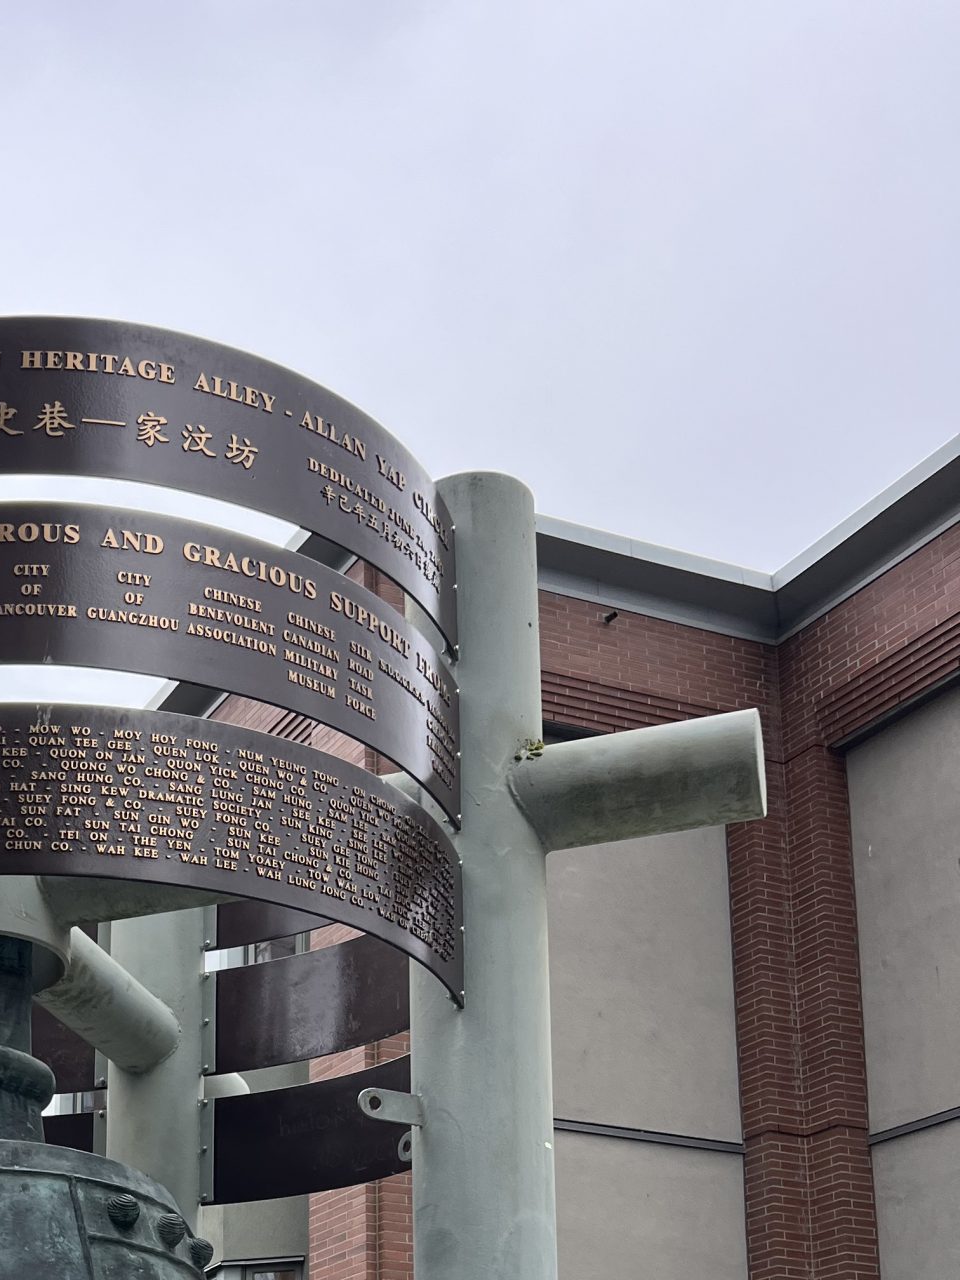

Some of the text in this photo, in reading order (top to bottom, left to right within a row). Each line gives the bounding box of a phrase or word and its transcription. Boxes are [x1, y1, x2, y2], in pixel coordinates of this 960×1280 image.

[20, 350, 176, 385] HERITAGE
[193, 372, 276, 413] ALLEY
[299, 410, 367, 461] ALLAN
[376, 453, 407, 492] YAP
[307, 457, 386, 513] DEDICATED
[13, 564, 50, 577] CITY
[117, 571, 152, 587] CITY
[20, 584, 42, 596] OF
[101, 528, 165, 555] AND
[183, 541, 317, 600] GRACIOUS
[330, 591, 411, 659] SUPPORT
[124, 592, 144, 605] OF
[204, 587, 262, 613] CHINESE
[87, 607, 179, 630] GUANGZHOU
[188, 603, 276, 636] BENEVOLENT
[288, 612, 336, 641] CHINESE
[186, 623, 277, 656] ASSOCIATION
[283, 629, 340, 663] CANADIAN
[350, 641, 373, 663] SILK
[284, 650, 338, 681] MILITARY
[348, 659, 374, 681] ROAD
[288, 670, 336, 699] MUSEUM
[349, 678, 374, 700] TASK
[346, 695, 377, 721] FORCE
[29, 724, 61, 734] MOW
[71, 726, 91, 735] WO
[114, 729, 142, 740] MOY
[151, 733, 177, 745] HOY
[186, 738, 218, 752] FONG
[238, 748, 263, 763] NUM
[271, 756, 307, 775] YEUNG
[313, 769, 339, 787] TONG
[28, 736, 66, 746] QUAN
[74, 738, 98, 748] TEE
[107, 740, 132, 751] GEE
[153, 745, 188, 758] QUEN
[195, 751, 220, 764] LOK
[239, 760, 270, 775] QUEN
[277, 770, 294, 782] WO
[300, 777, 307, 787] &
[350, 795, 373, 813] QUEN
[2, 759, 25, 768] CO.
[61, 760, 107, 772] QUONG
[116, 764, 136, 774] WO
[145, 767, 189, 781] CHONG
[196, 775, 206, 784] &
[253, 786, 276, 799] SAM
[283, 794, 312, 810] HUNG
[328, 808, 348, 823] SAM
[352, 818, 369, 832] LEE
[9, 782, 37, 792] HAT
[60, 783, 91, 794] SING
[101, 786, 129, 797] KEW
[138, 789, 205, 807] DRAMATIC
[212, 800, 262, 818] SOCIETY
[5, 841, 42, 850] CHUN
[51, 841, 73, 852] CO.
[96, 844, 125, 855] WAH
[134, 847, 159, 859] KEE
[180, 852, 208, 866] WAH
[215, 858, 238, 871] LEE
[256, 867, 281, 881] WAH
[288, 875, 316, 890] LUNG
[322, 885, 346, 900] JONG
[6, 829, 29, 838] CO.
[59, 830, 79, 840] TEI
[89, 832, 108, 842] ON
[132, 835, 157, 847] THE
[167, 839, 192, 851] YEN
[214, 847, 240, 859] TOM
[308, 868, 330, 883] TOW
[337, 878, 357, 893] WAH
[362, 889, 381, 903] LOW
